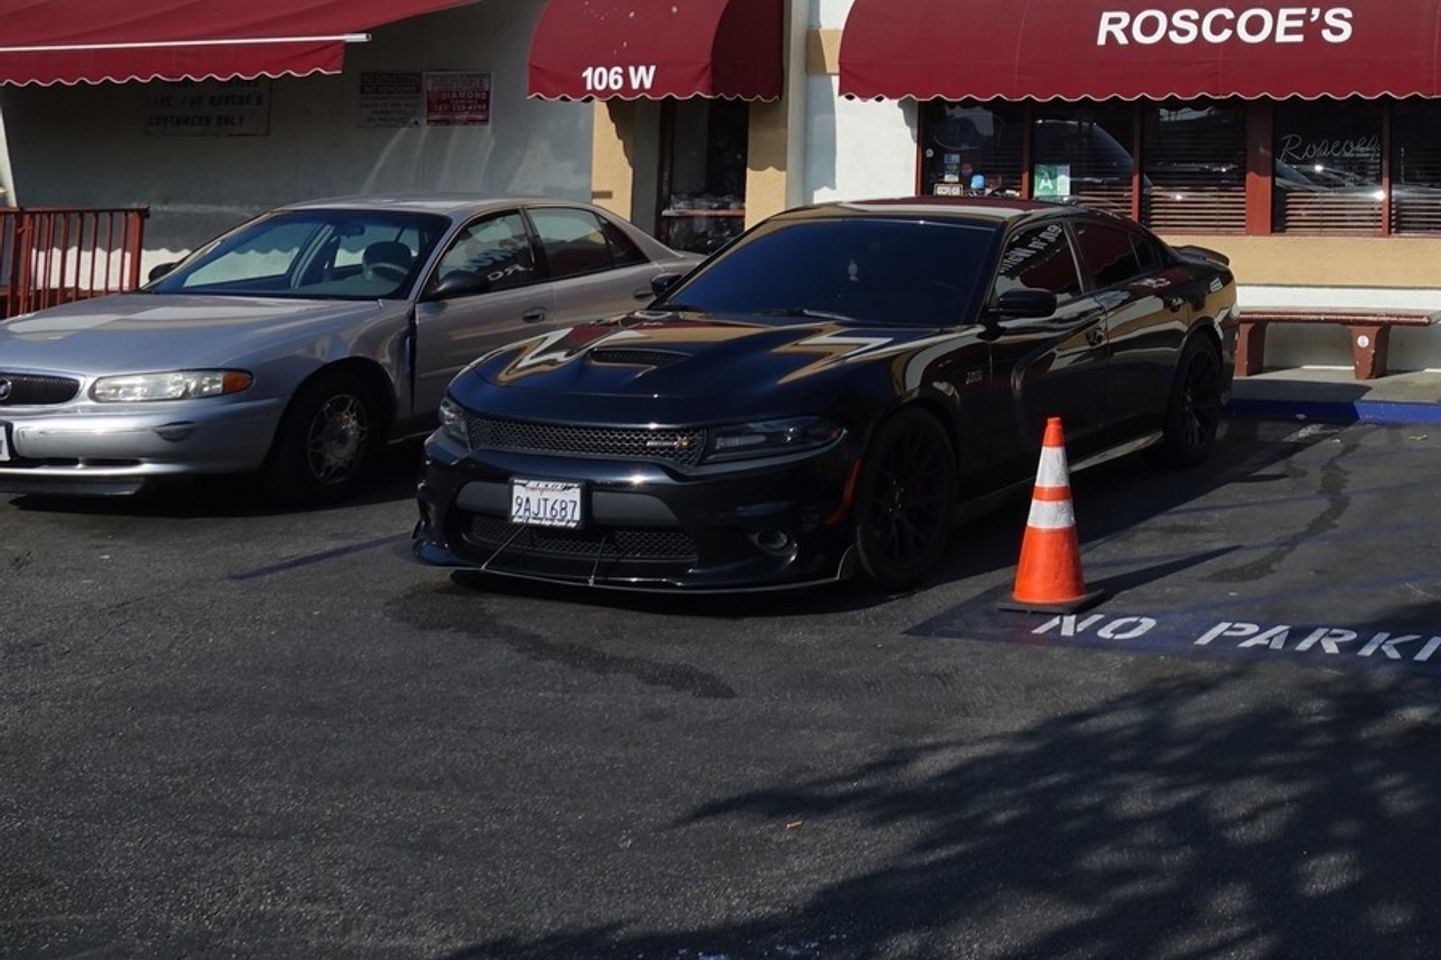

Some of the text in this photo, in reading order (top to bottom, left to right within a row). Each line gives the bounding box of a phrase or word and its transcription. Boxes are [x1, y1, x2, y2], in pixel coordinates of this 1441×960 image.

[1096, 7, 1354, 46] ROSCOE'S
[581, 65, 656, 90] 106 W
[515, 495, 578, 521] 9AJT687
[1032, 613, 1156, 640] NO
